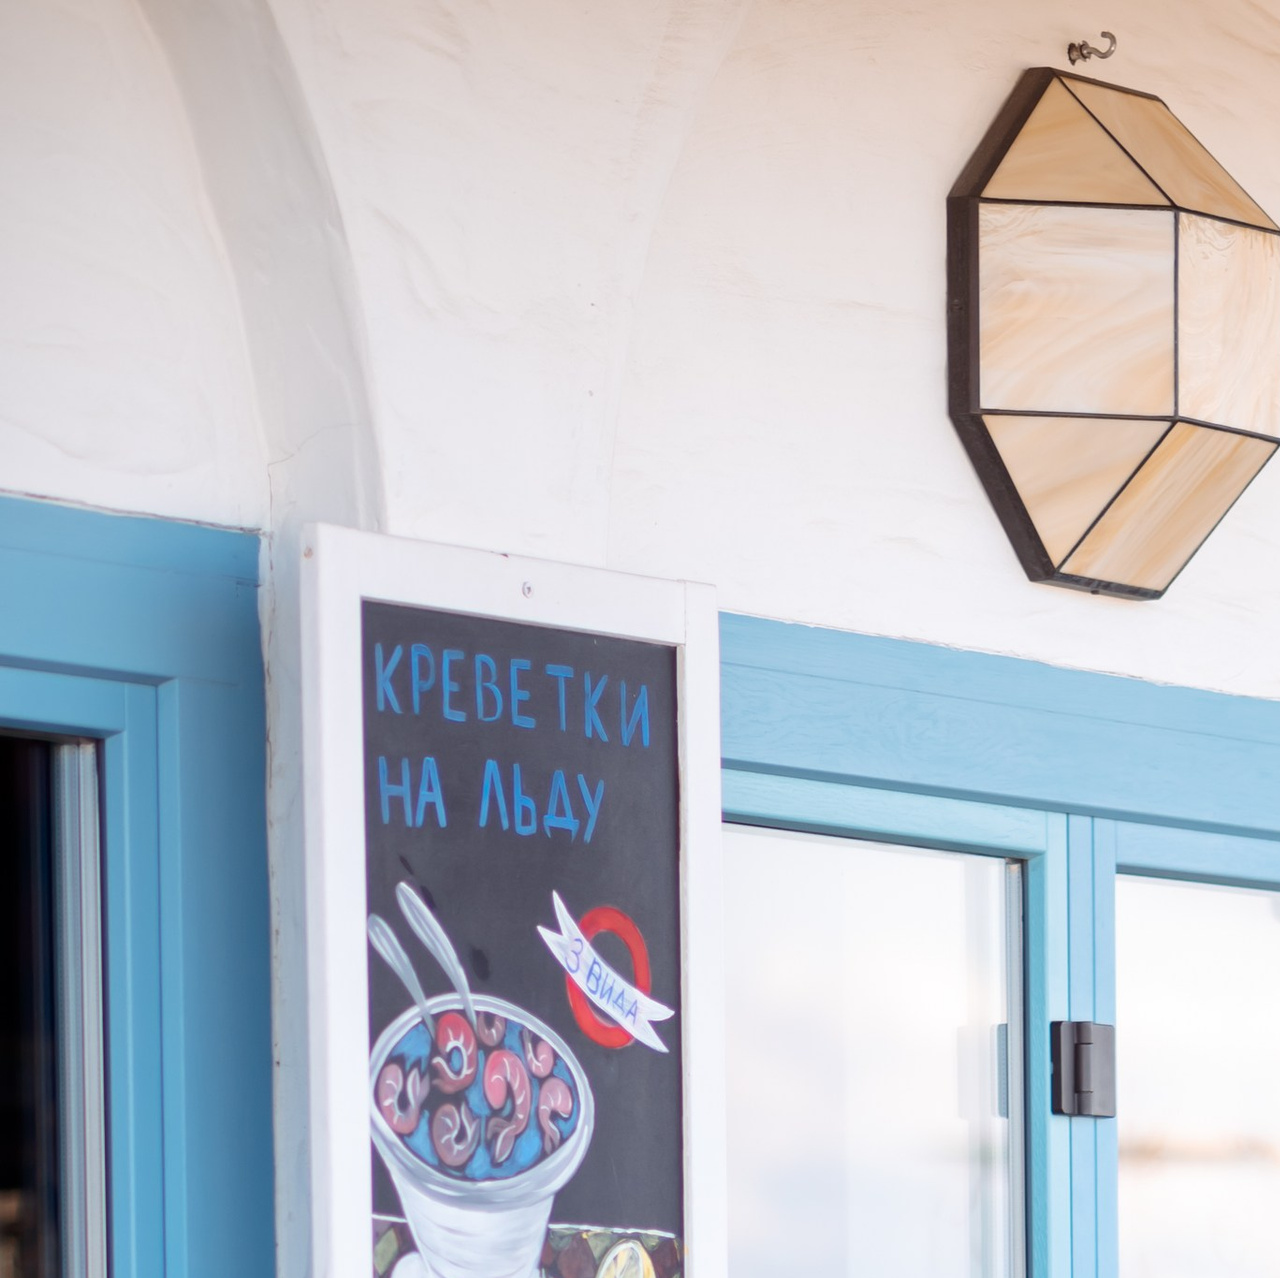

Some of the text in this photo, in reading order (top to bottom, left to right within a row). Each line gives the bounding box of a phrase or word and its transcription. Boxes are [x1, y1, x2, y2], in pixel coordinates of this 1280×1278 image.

[374, 642, 651, 747] КРЕВЕТКИ
[378, 755, 605, 845] НА ЛЬДУ
[565, 938, 639, 1025] 3 ВИДА
